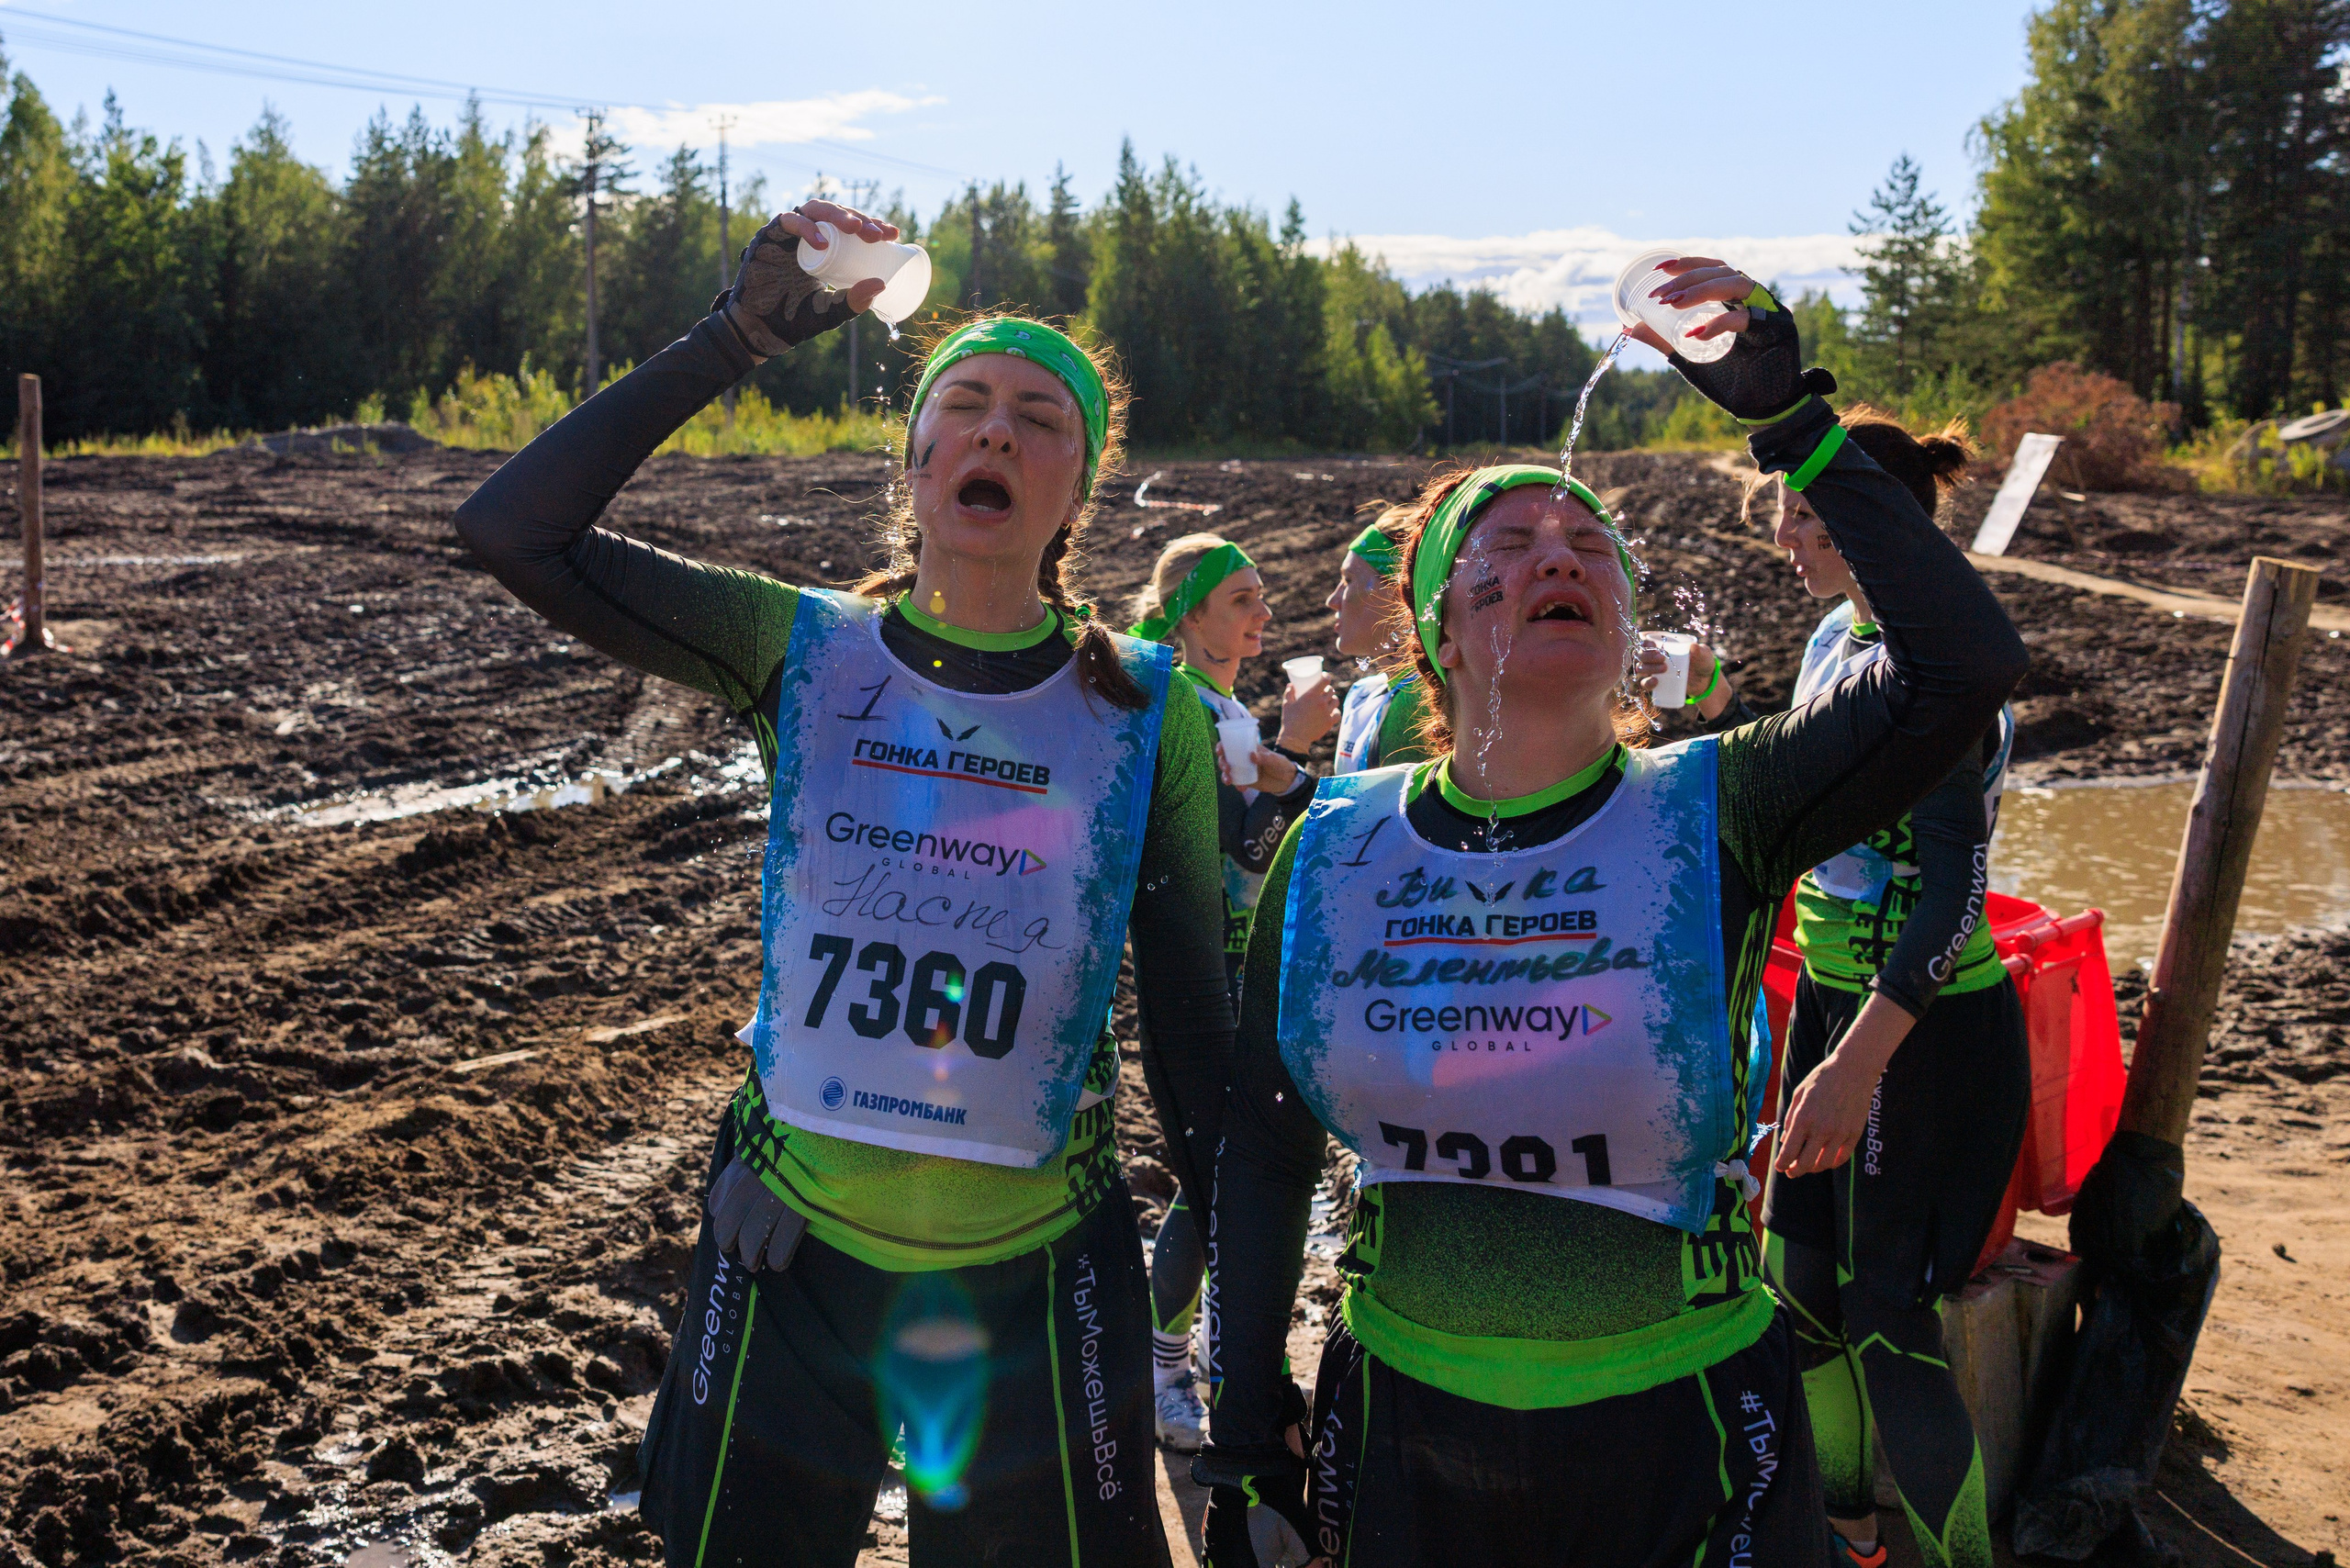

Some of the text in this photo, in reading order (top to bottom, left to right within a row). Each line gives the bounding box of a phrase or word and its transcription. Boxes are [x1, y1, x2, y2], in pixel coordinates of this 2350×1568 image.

[837, 676, 892, 722] 1
[854, 738, 1050, 786] ГОНКА ГЕРОЕВ
[826, 812, 1020, 877] Greenway
[1338, 814, 1392, 868] 1
[882, 857, 971, 880] GLOBAL
[1384, 910, 1597, 938] ГОНКА ГЕРОЕВ
[803, 932, 1027, 1059] 7360
[1364, 999, 1583, 1041] Greenway
[1432, 1041, 1531, 1052] GLOBAL
[853, 1090, 968, 1126] ГАЗПРОМБАНК
